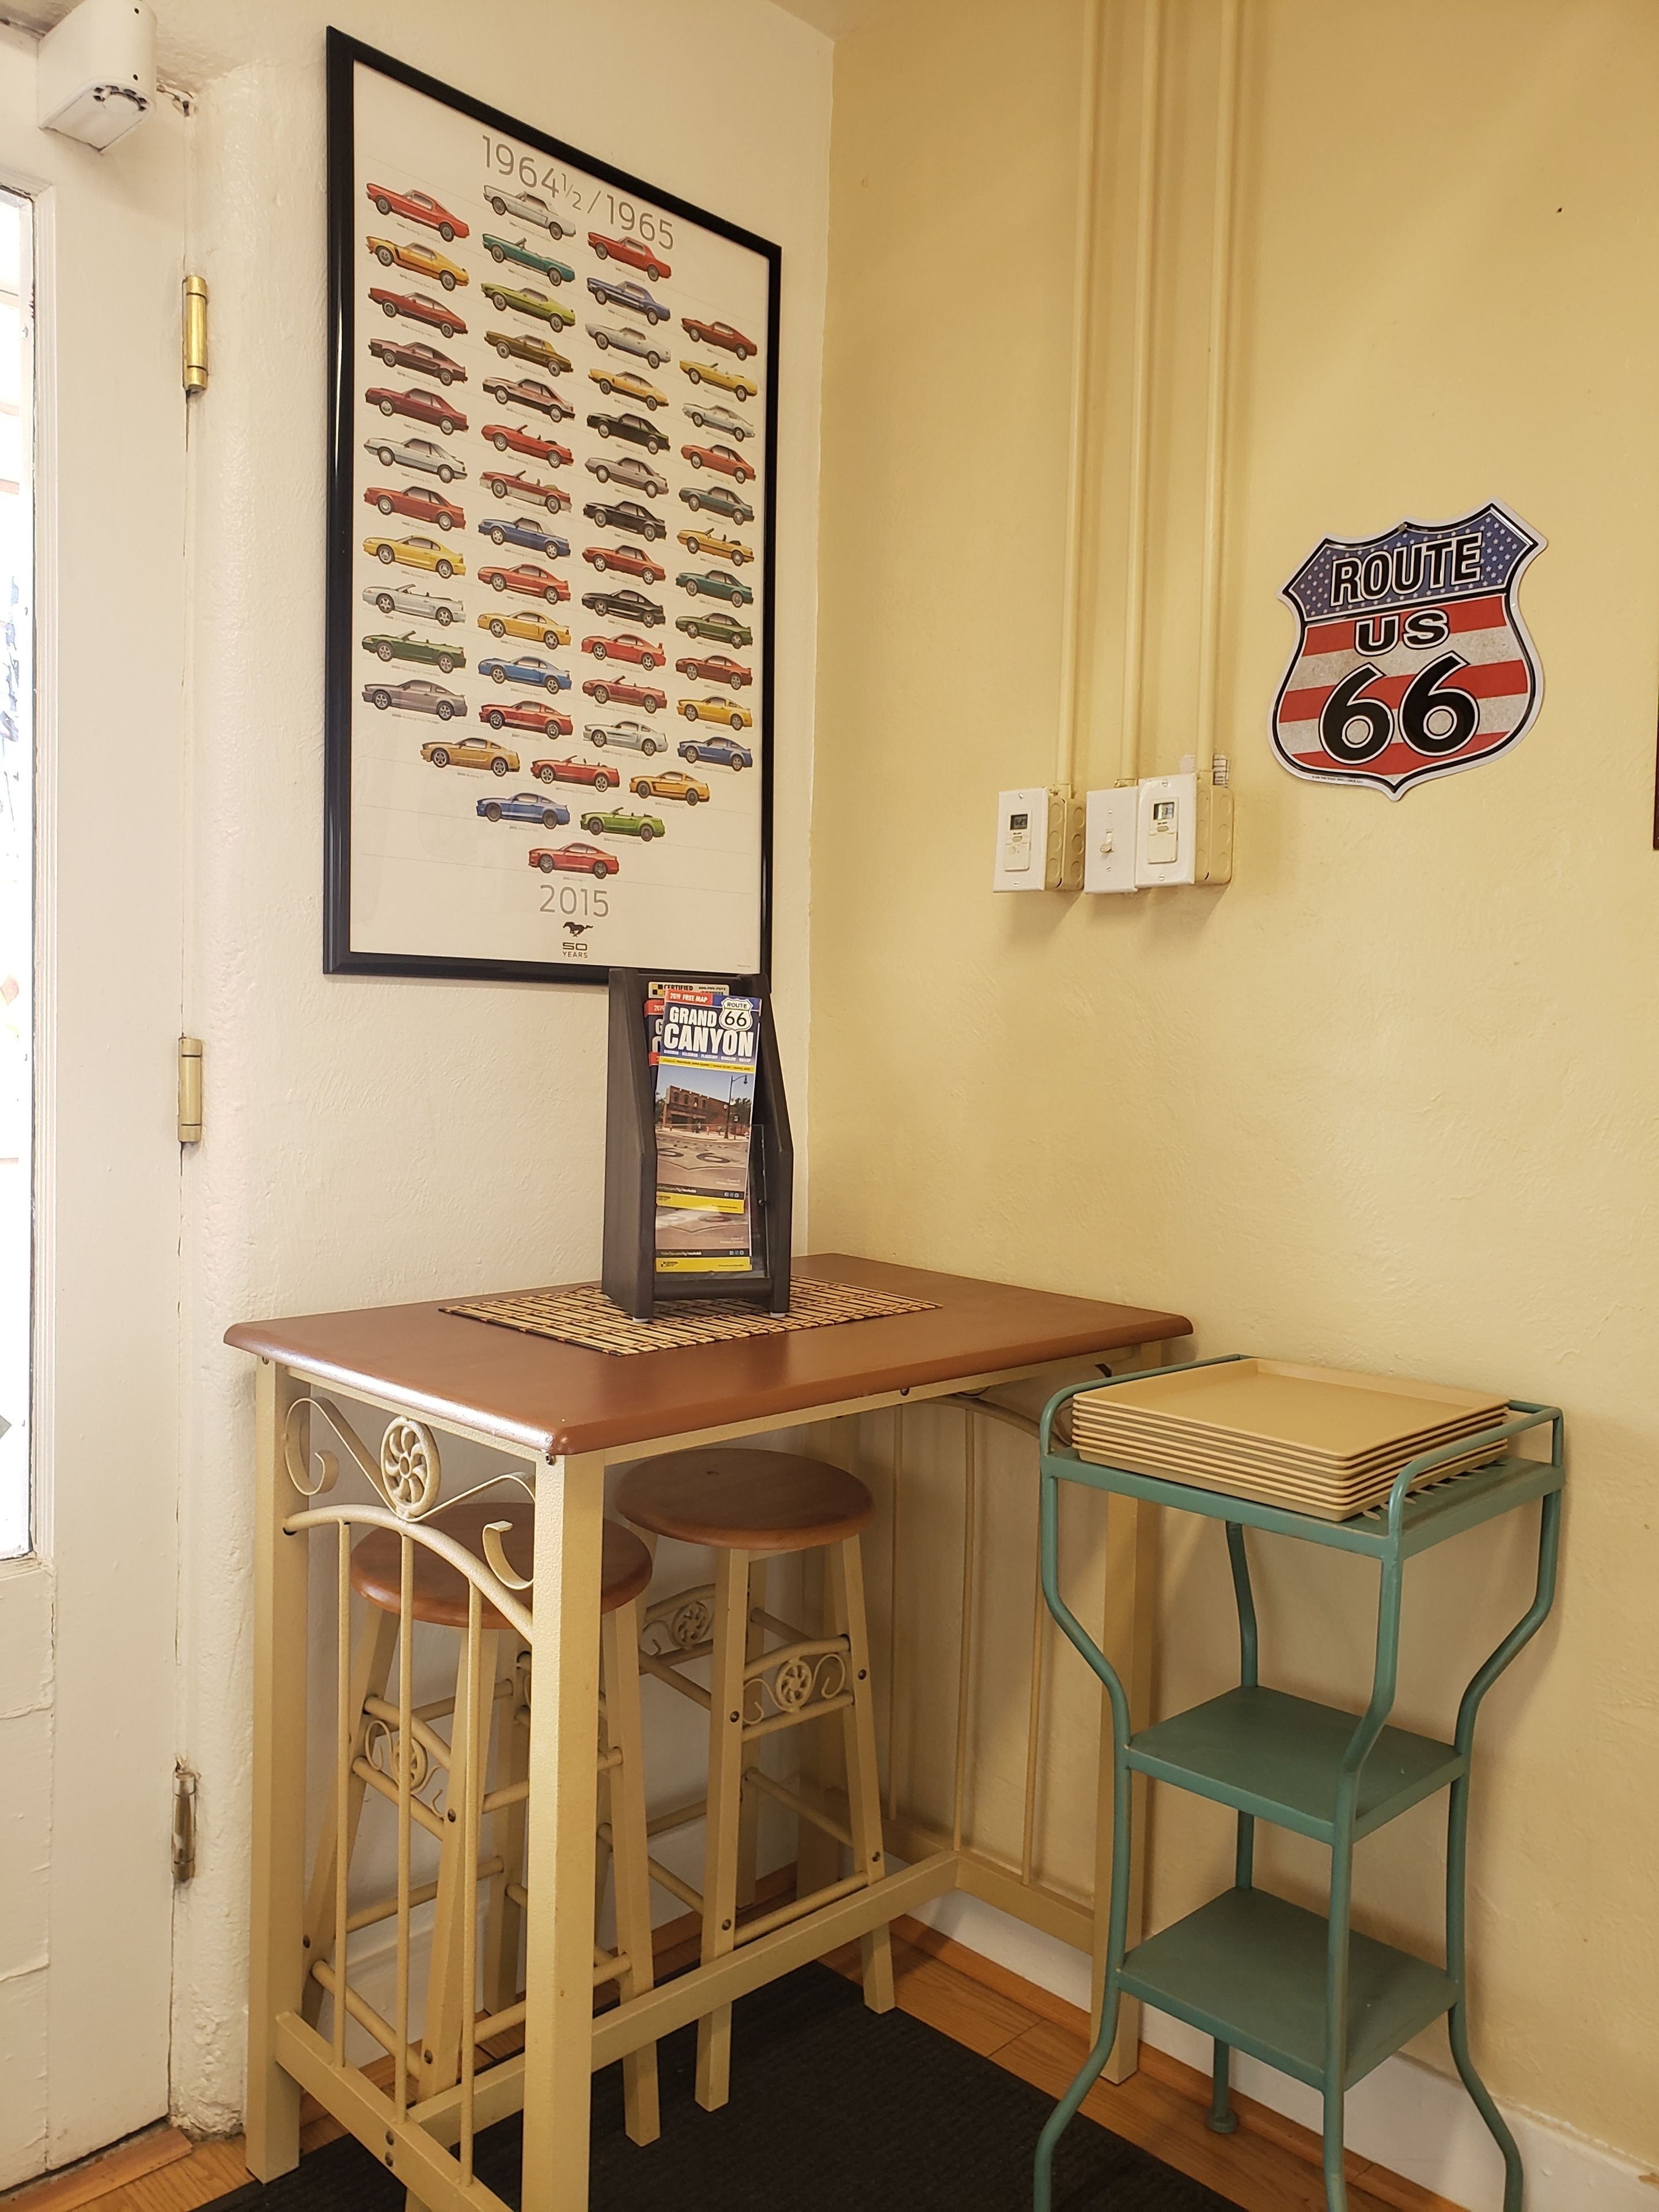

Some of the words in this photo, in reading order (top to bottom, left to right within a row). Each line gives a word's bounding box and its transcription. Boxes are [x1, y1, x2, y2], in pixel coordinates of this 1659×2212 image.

[1329, 531, 1484, 608] ROUTE
[1354, 608, 1451, 657] US
[1318, 650, 1480, 764] 66
[539, 884, 609, 918] 2015
[562, 942, 588, 951] 50
[669, 1006, 717, 1027] GRAND
[724, 1010, 748, 1027] 66
[664, 1023, 754, 1057] CANYON
